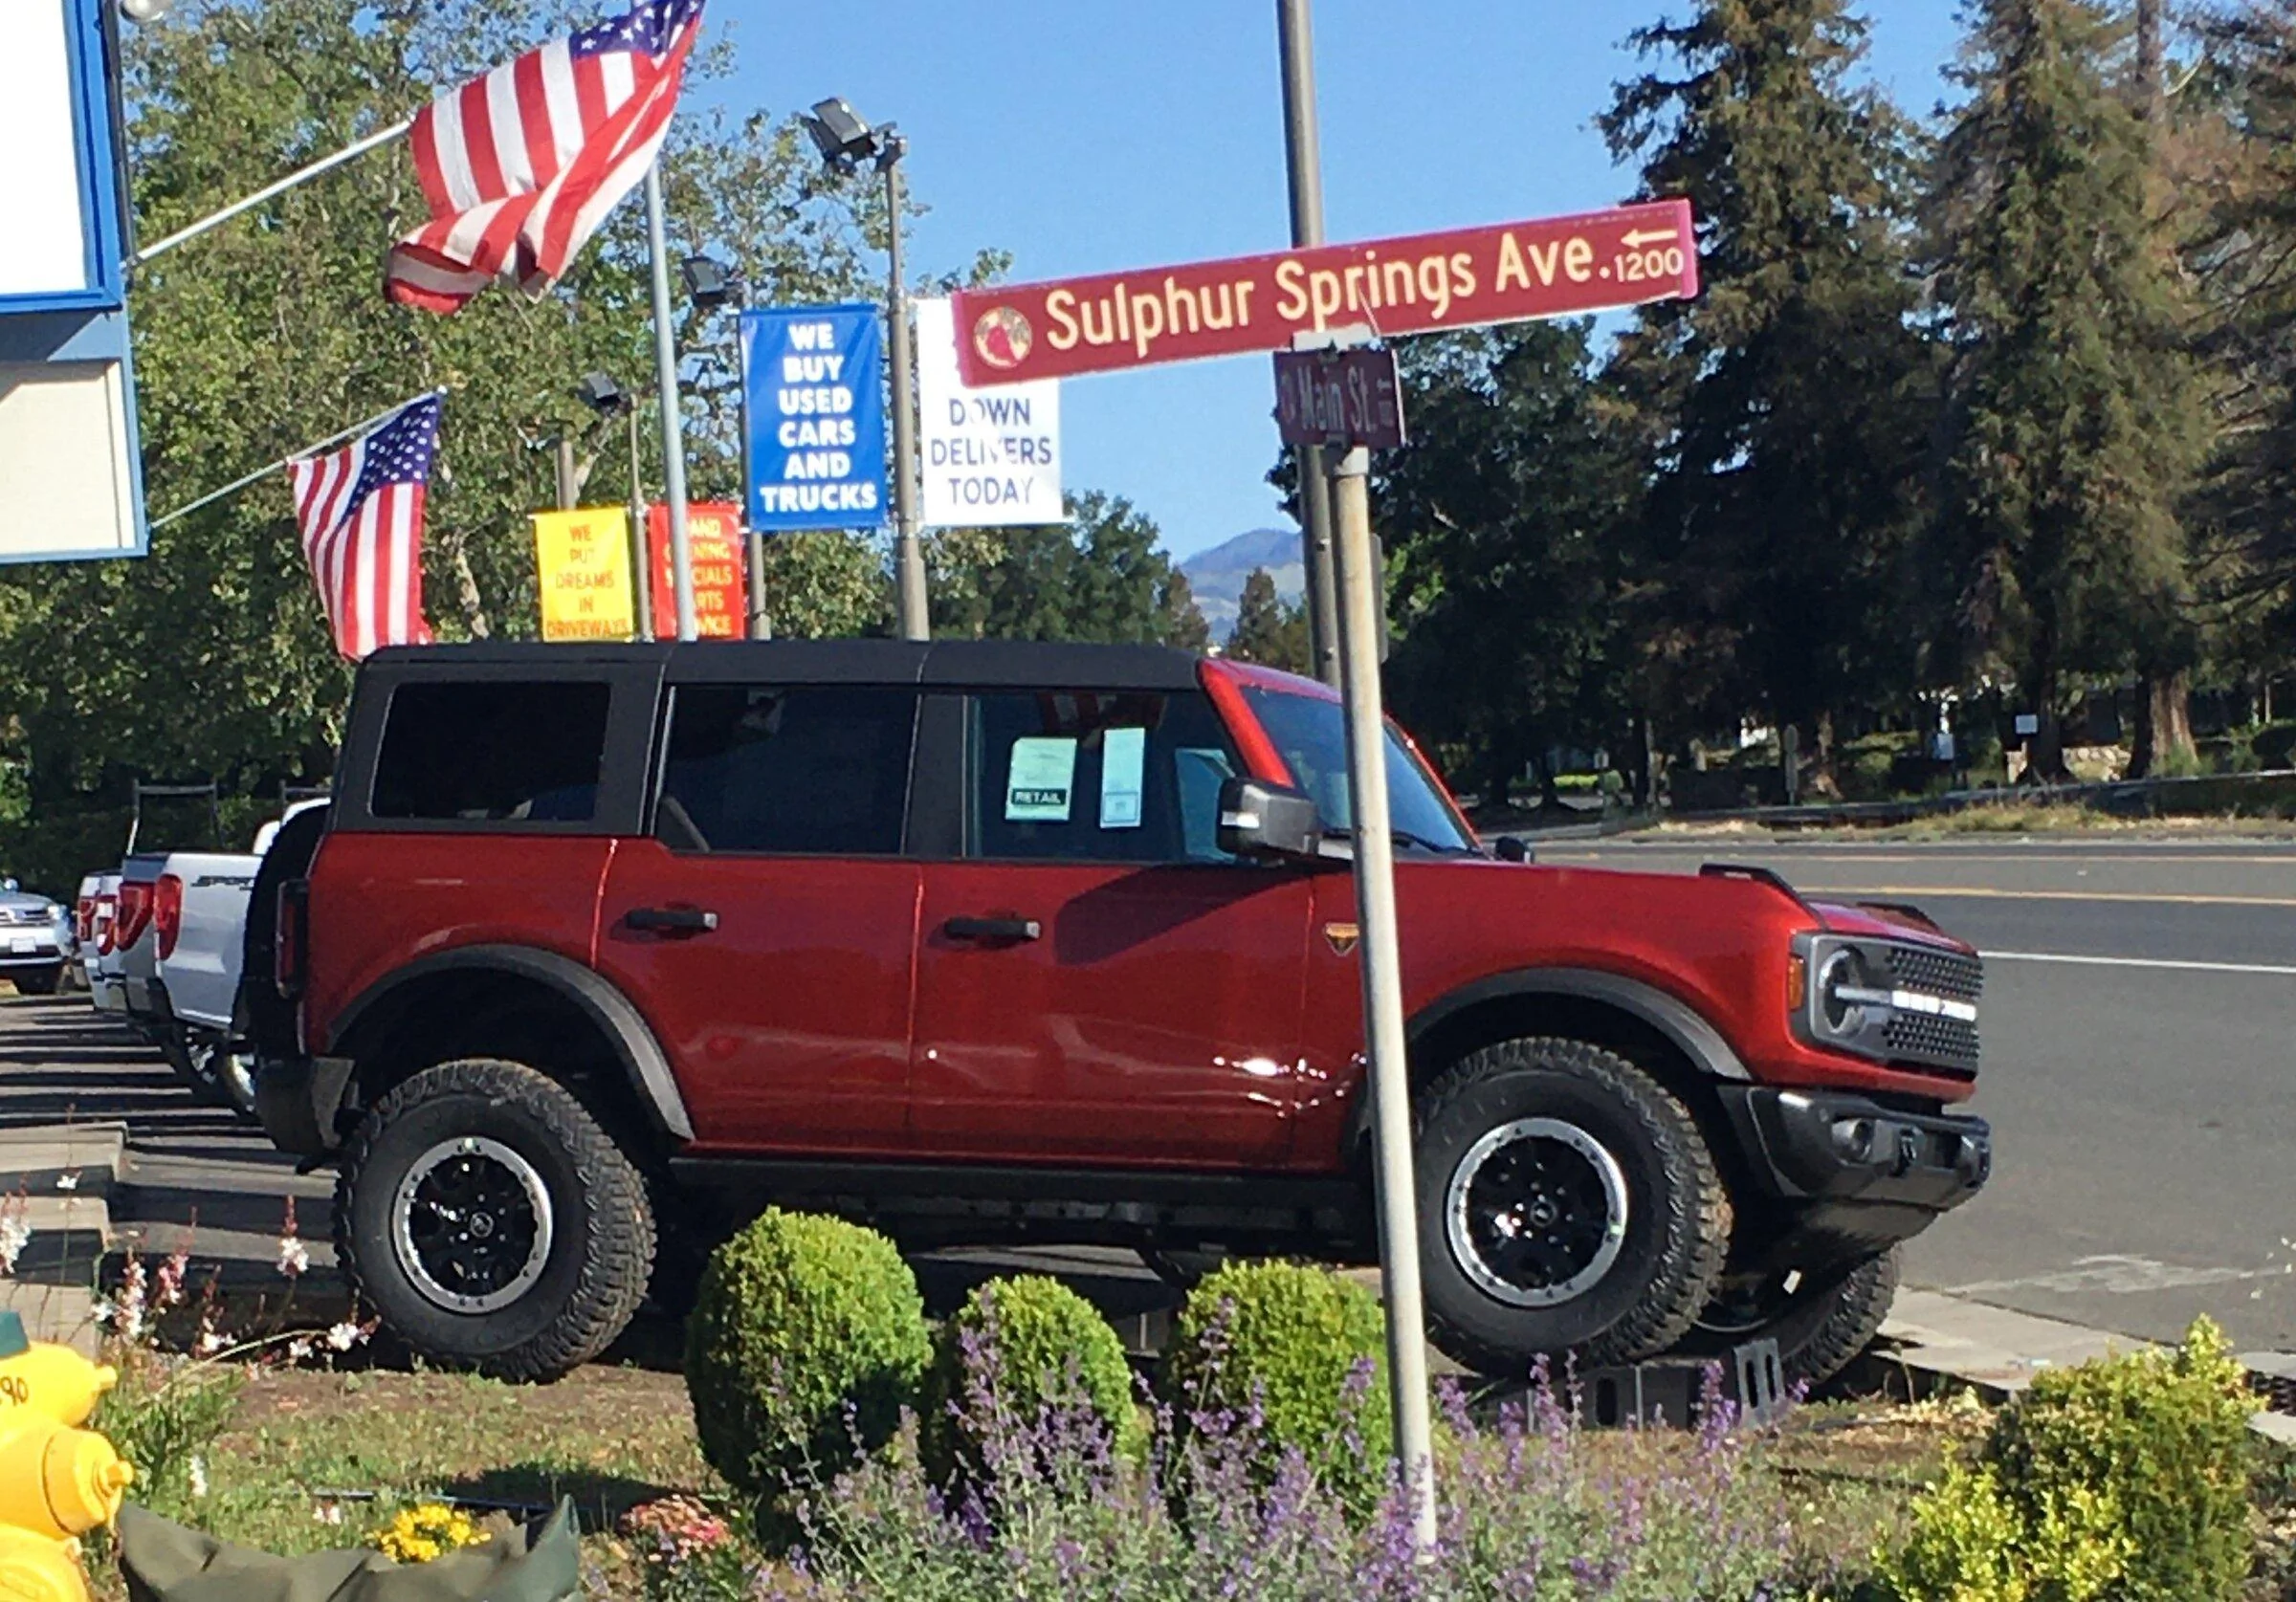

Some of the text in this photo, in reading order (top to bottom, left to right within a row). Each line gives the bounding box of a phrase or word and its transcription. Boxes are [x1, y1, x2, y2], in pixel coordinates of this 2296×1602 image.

[1046, 231, 1684, 359] Sulphur Springs Ave. 1200
[788, 322, 834, 351] WE
[783, 355, 844, 383] BUY
[778, 387, 853, 416] USED
[948, 397, 1031, 427] DOWN
[1296, 364, 1346, 431] Main
[778, 420, 856, 449] CARS
[784, 451, 850, 480] AND
[760, 483, 877, 513] TRUCKS
[948, 476, 1034, 505] TODAY
[569, 523, 593, 543] WE
[556, 569, 615, 589] DREAMS
[578, 595, 594, 614] IN
